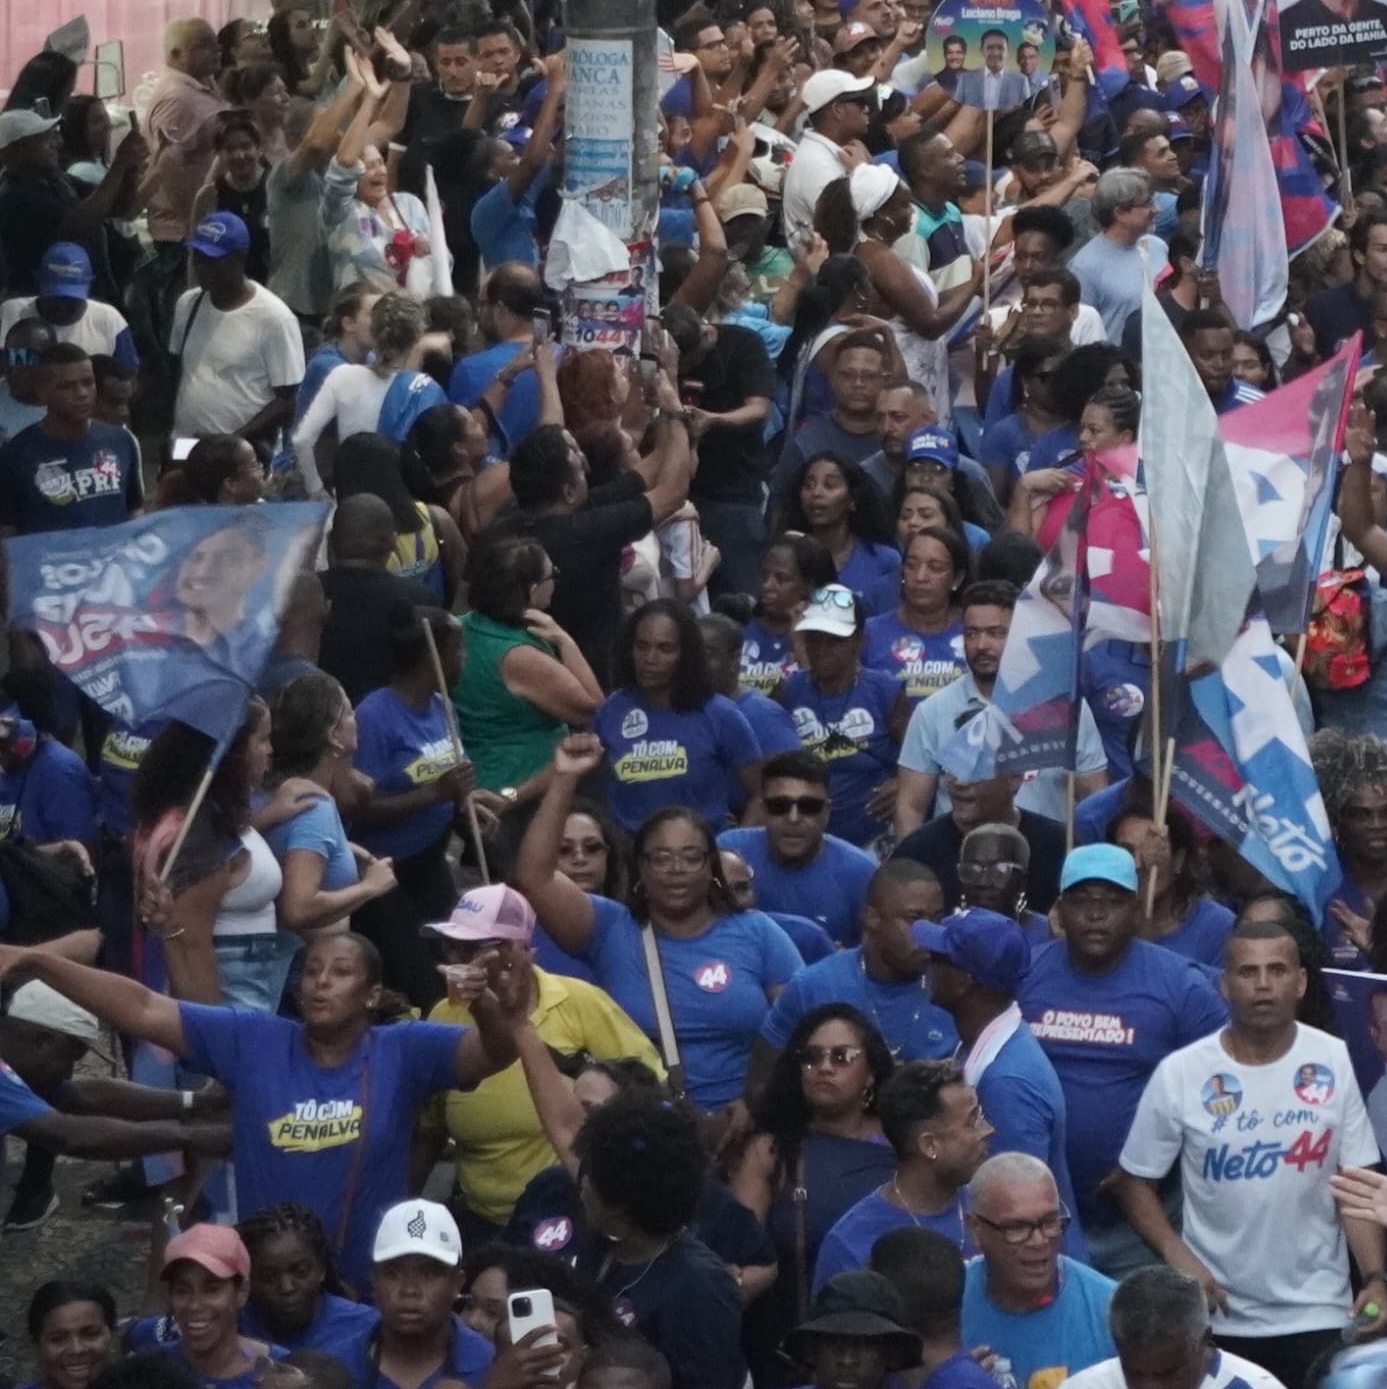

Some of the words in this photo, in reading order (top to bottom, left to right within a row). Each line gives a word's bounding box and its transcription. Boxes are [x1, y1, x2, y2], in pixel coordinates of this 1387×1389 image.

[1295, 25, 1330, 40] PERTO
[1308, 35, 1338, 49] LADO
[651, 739, 678, 756] COM
[620, 756, 688, 778] PENALVA
[1229, 777, 1328, 875] Neto
[698, 964, 728, 988] 44
[277, 1119, 361, 1141] PENALVA
[1202, 1139, 1293, 1182] Neto
[1282, 1128, 1334, 1172] 44
